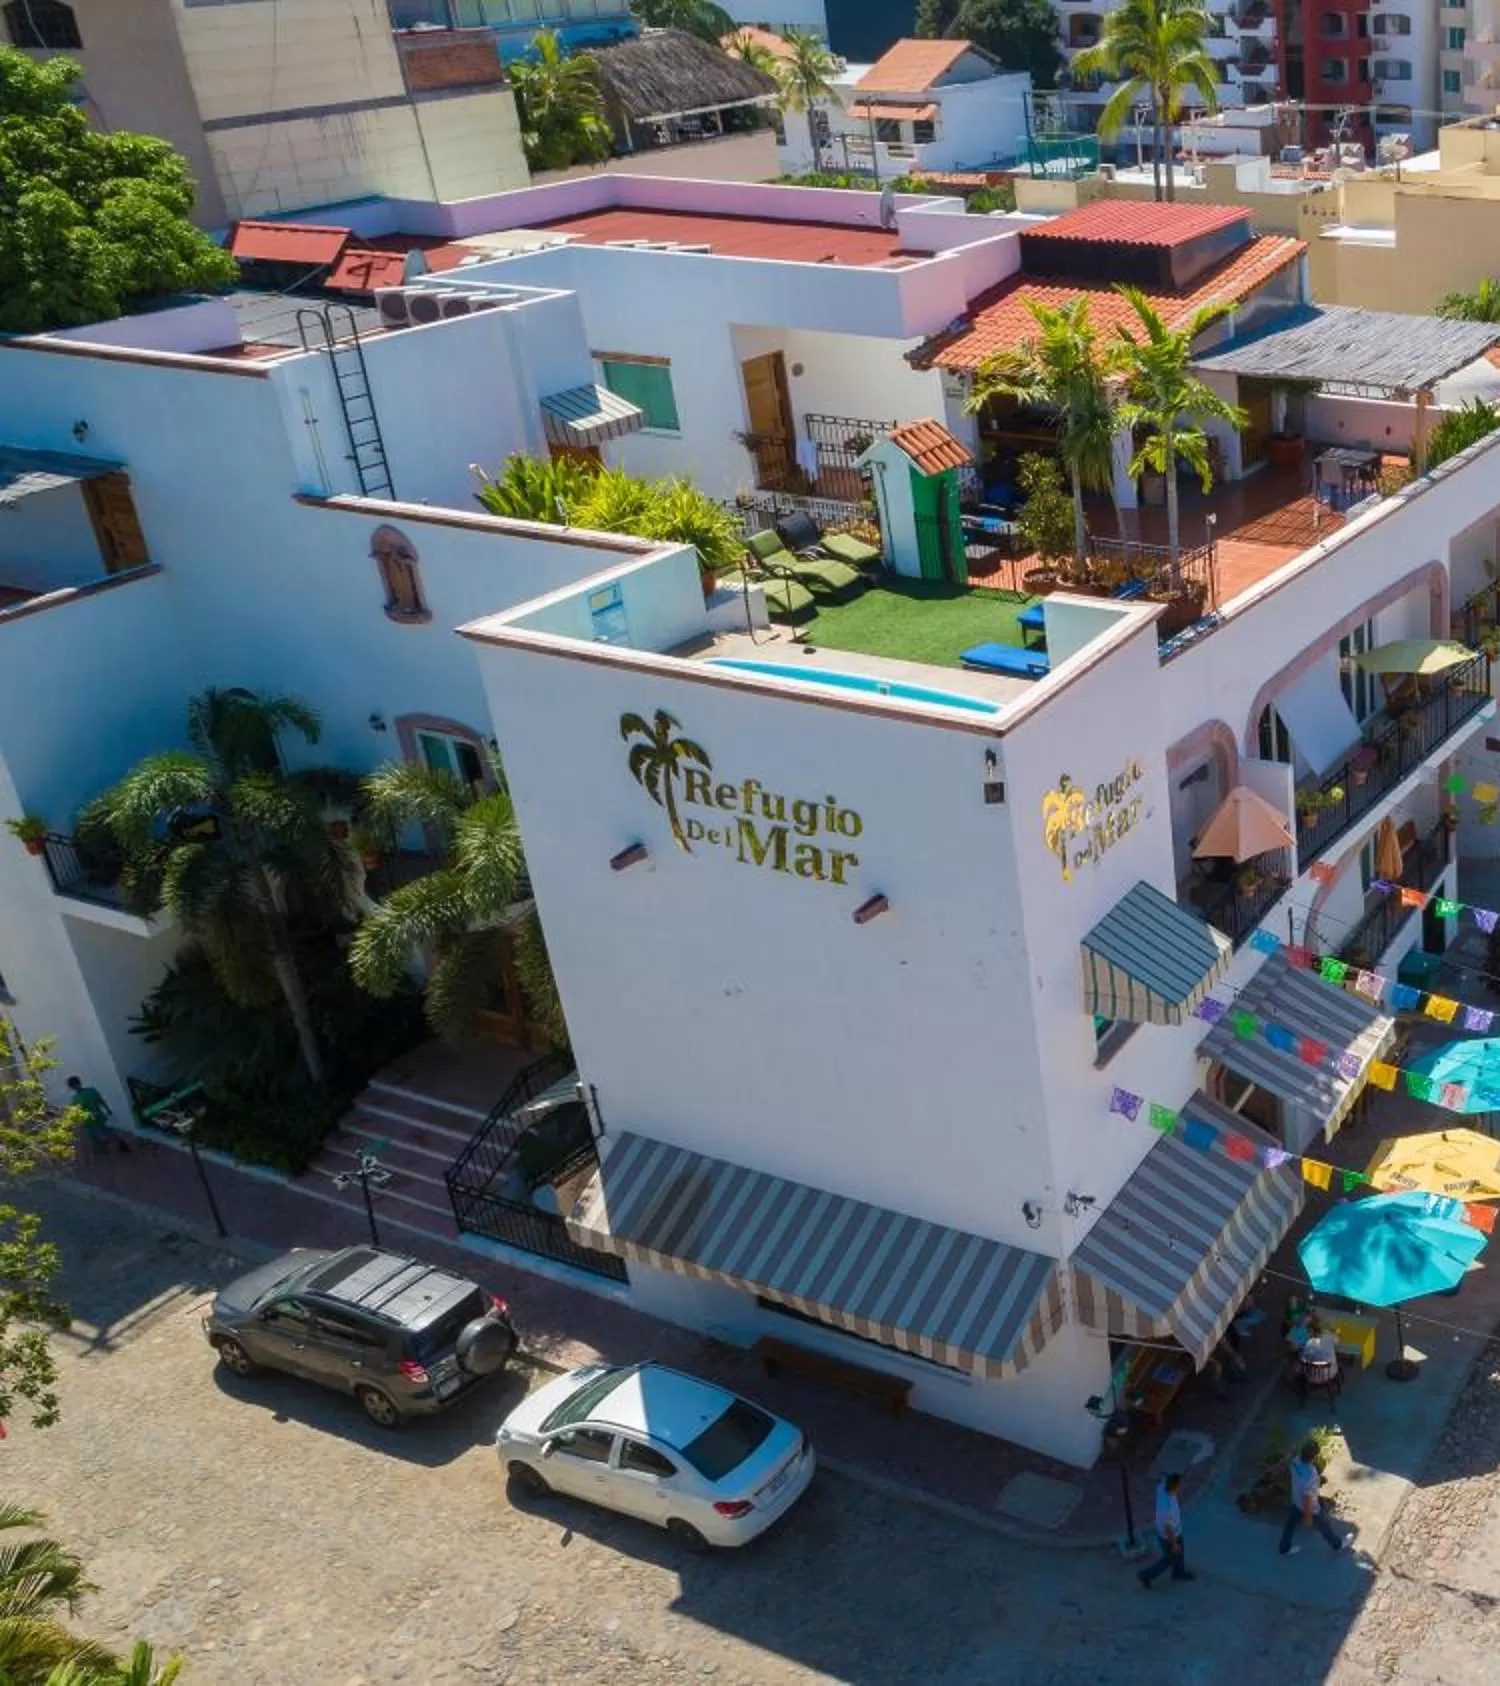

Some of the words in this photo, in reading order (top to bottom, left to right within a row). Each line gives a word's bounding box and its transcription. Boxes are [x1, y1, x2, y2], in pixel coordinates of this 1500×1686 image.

[683, 766, 863, 838] Refugio
[686, 818, 732, 848] Del
[735, 816, 860, 885] Mar
